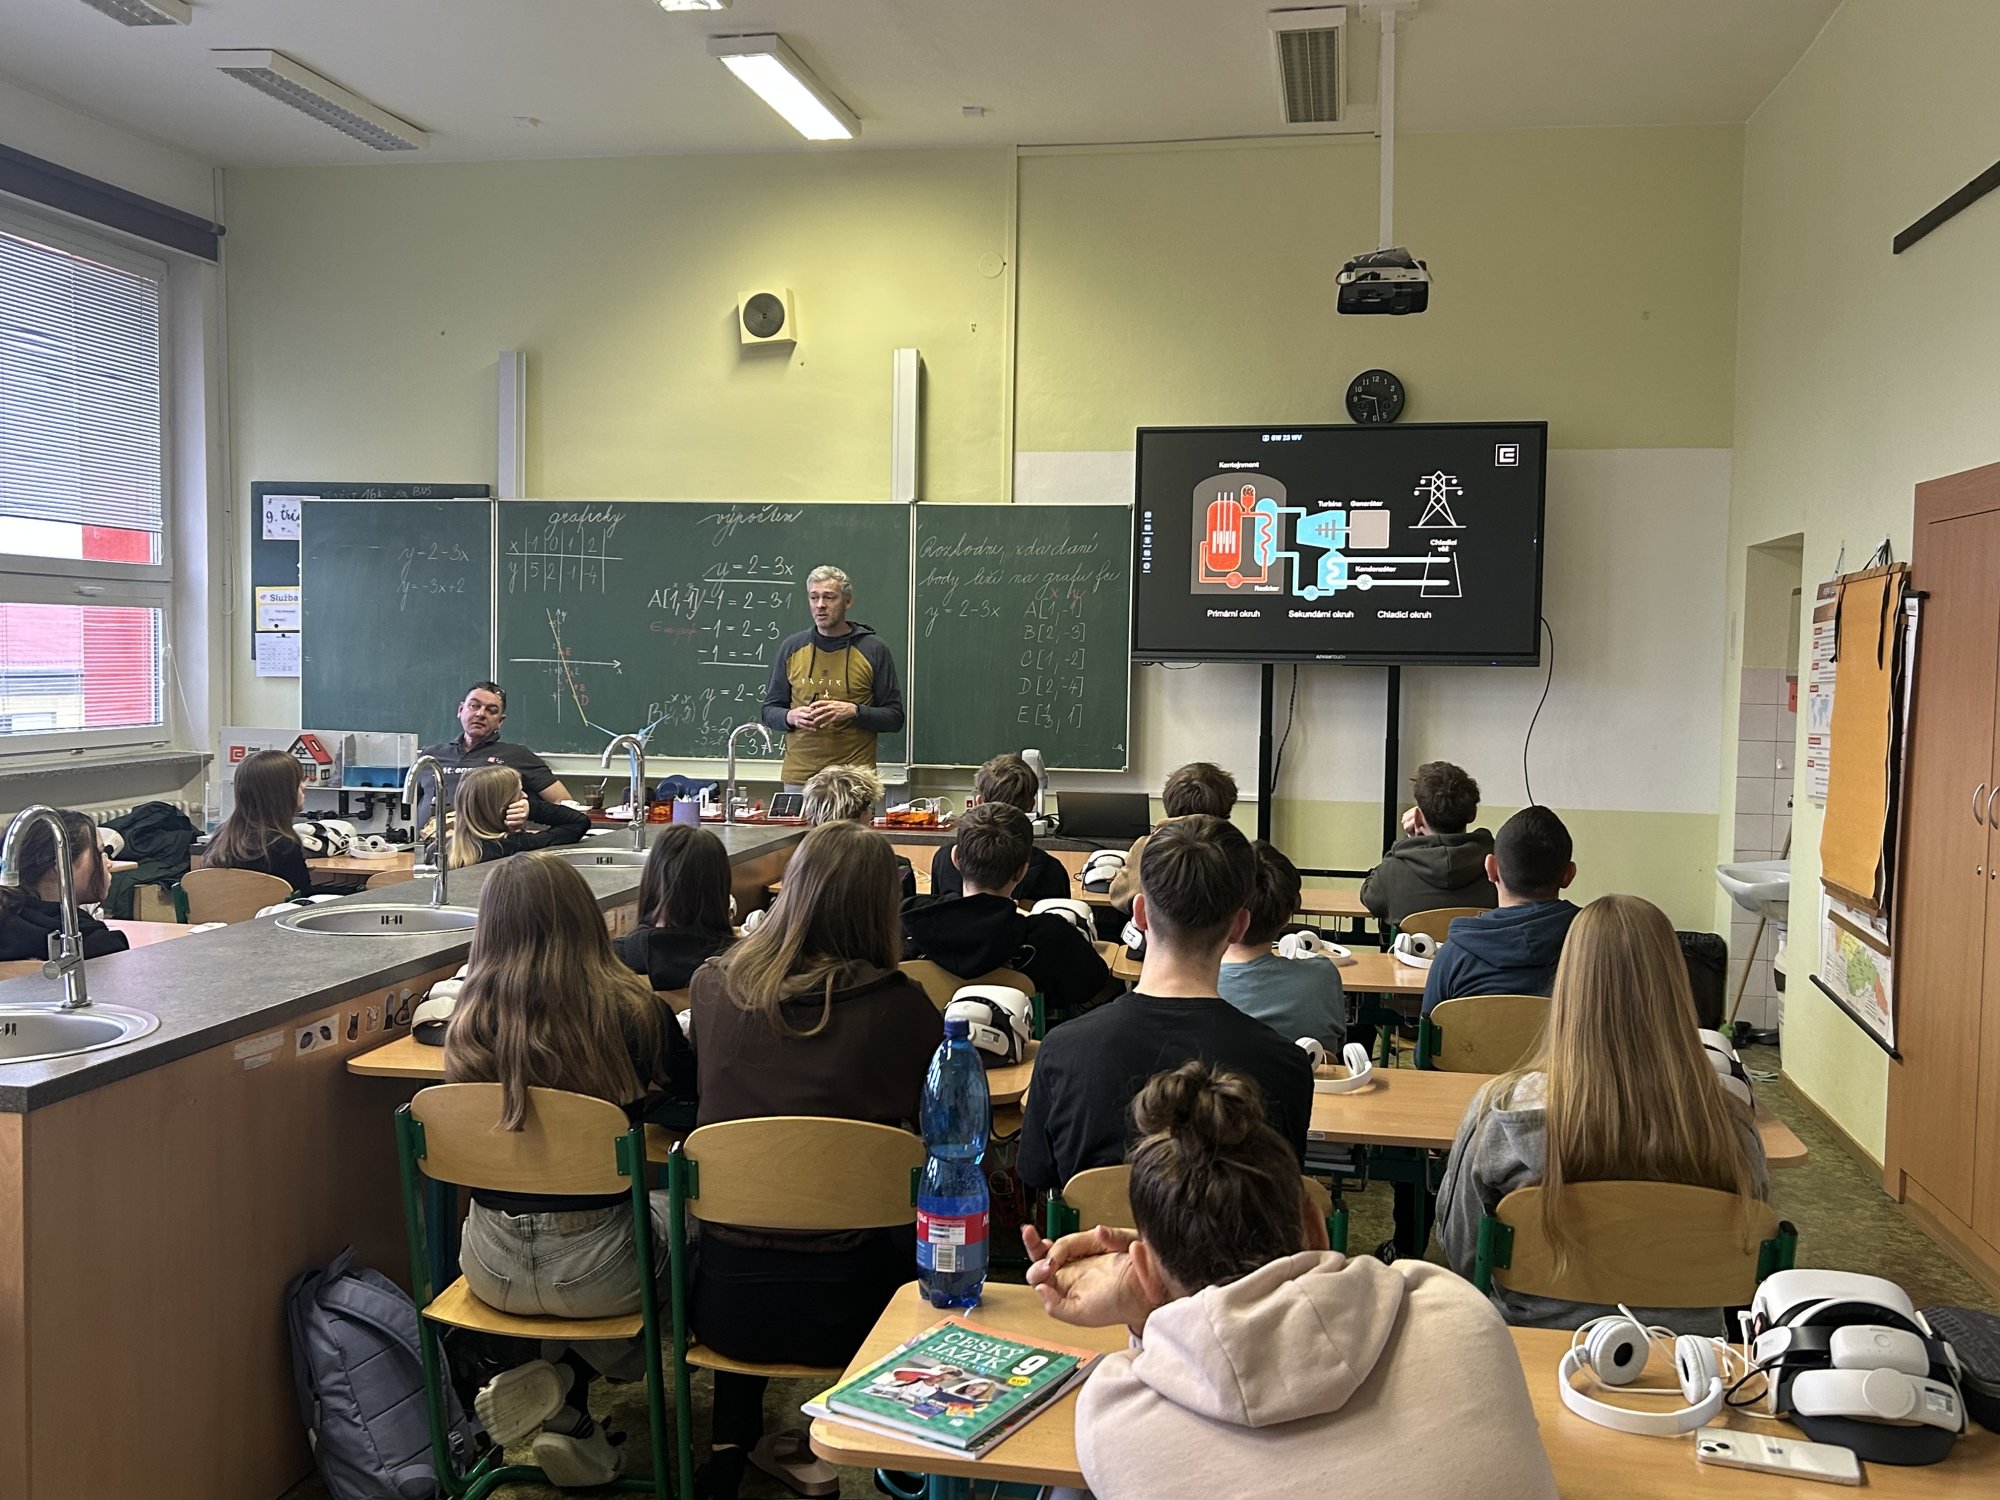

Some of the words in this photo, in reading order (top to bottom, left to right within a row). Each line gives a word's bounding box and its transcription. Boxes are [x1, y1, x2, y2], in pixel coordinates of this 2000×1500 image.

[544, 504, 627, 540] graficky
[918, 568, 960, 607] body
[1008, 573, 1040, 585] na
[1034, 562, 1093, 600] grafu
[1239, 609, 1261, 618] okruh
[1332, 610, 1354, 619] okruh
[1410, 610, 1432, 619] okruh
[927, 1342, 1008, 1369] JAZYK
[1011, 1354, 1049, 1376] 9
